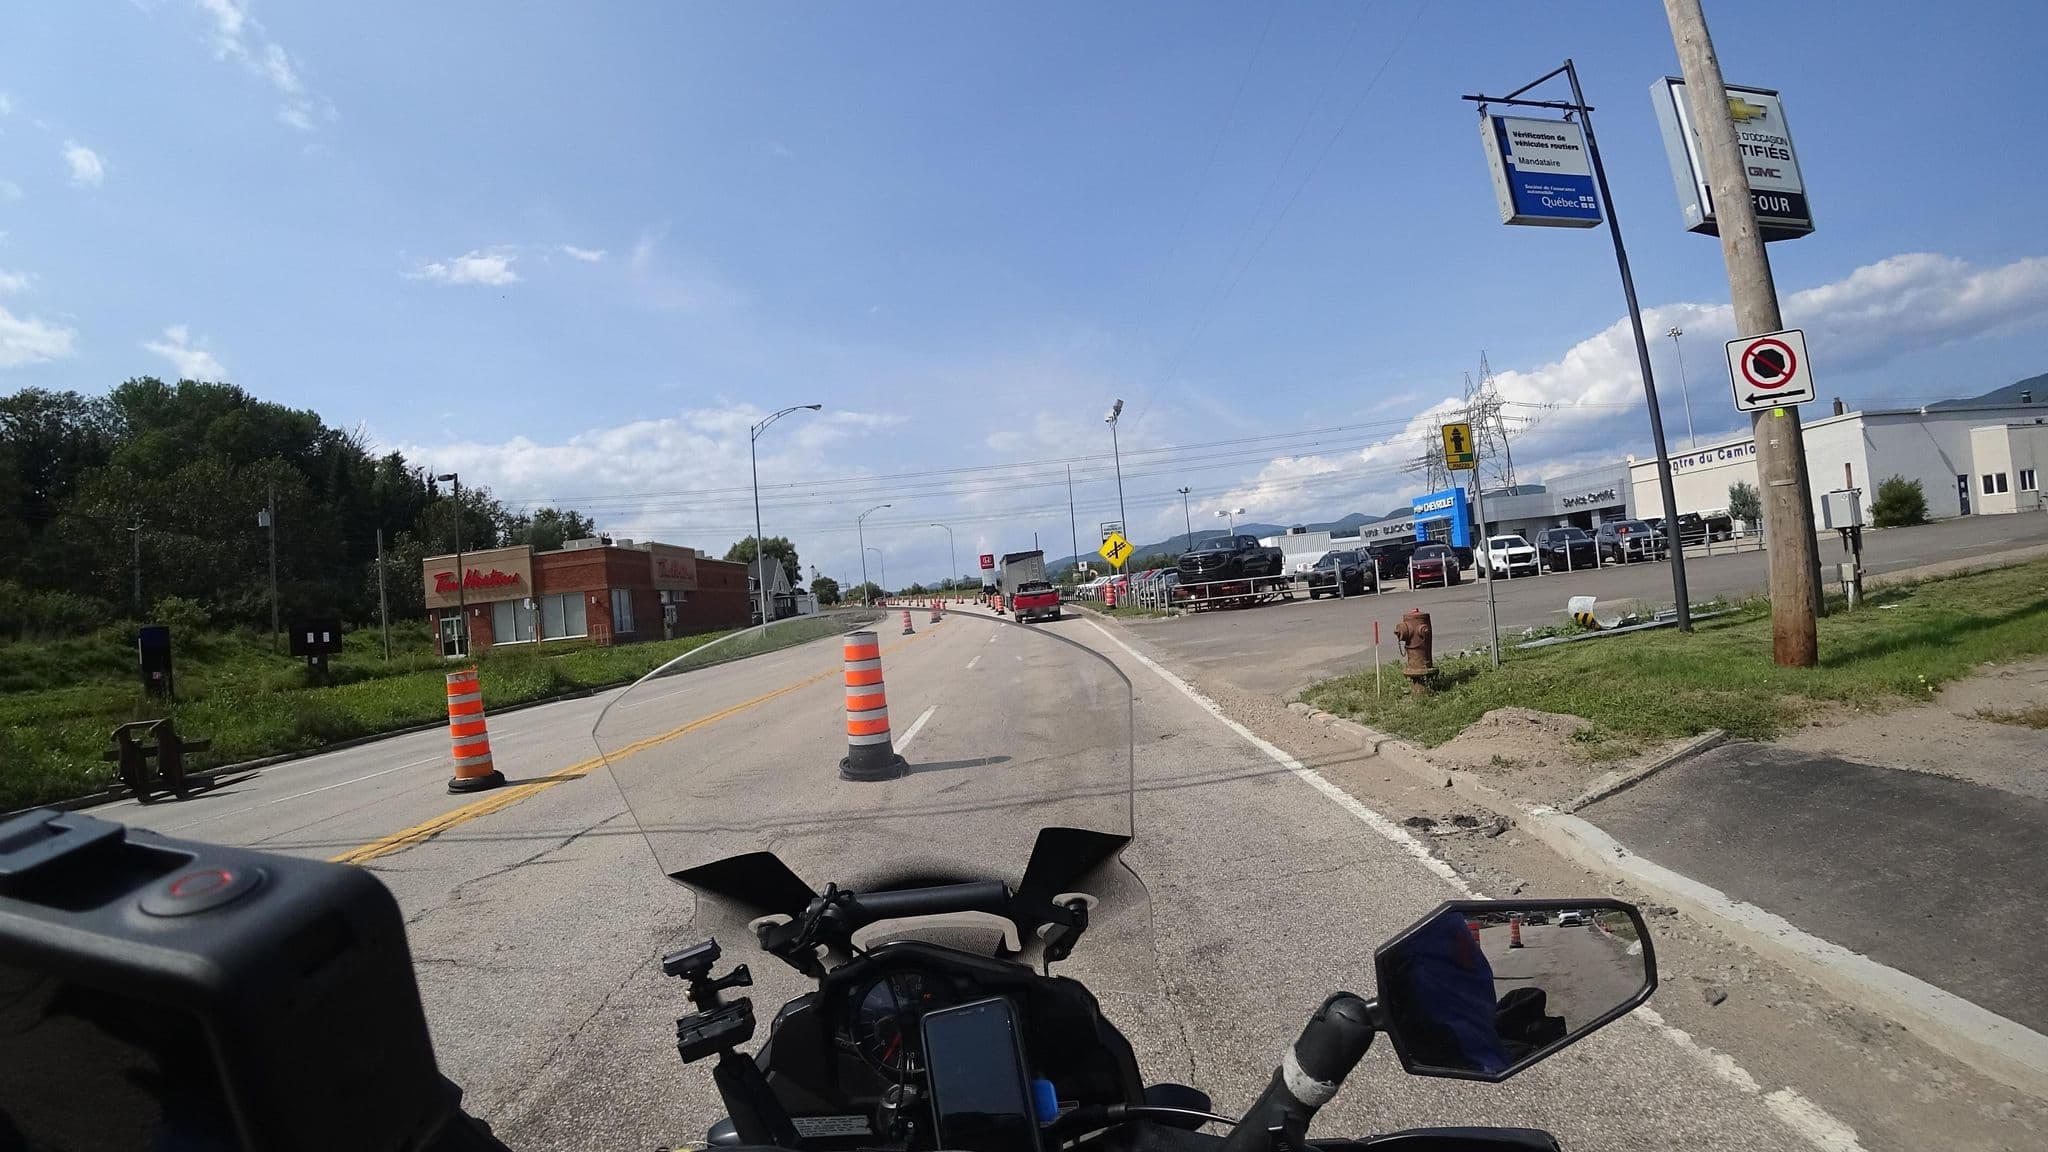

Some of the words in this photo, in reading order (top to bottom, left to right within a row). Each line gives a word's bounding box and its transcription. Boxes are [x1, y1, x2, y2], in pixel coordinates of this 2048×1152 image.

[1512, 131, 1556, 141] Vérification
[1742, 132, 1788, 146] D'OCCASION
[1514, 141, 1549, 149] véhicules
[1550, 143, 1579, 151] routiers
[1739, 144, 1790, 160] TIFIÉS
[1518, 157, 1561, 167] Mandataire
[1748, 166, 1782, 179] GMC
[1541, 196, 1580, 208] Québec
[1699, 453, 1713, 464] du
[1718, 443, 1756, 460] Camio
[1424, 497, 1455, 512] CHEVROLET
